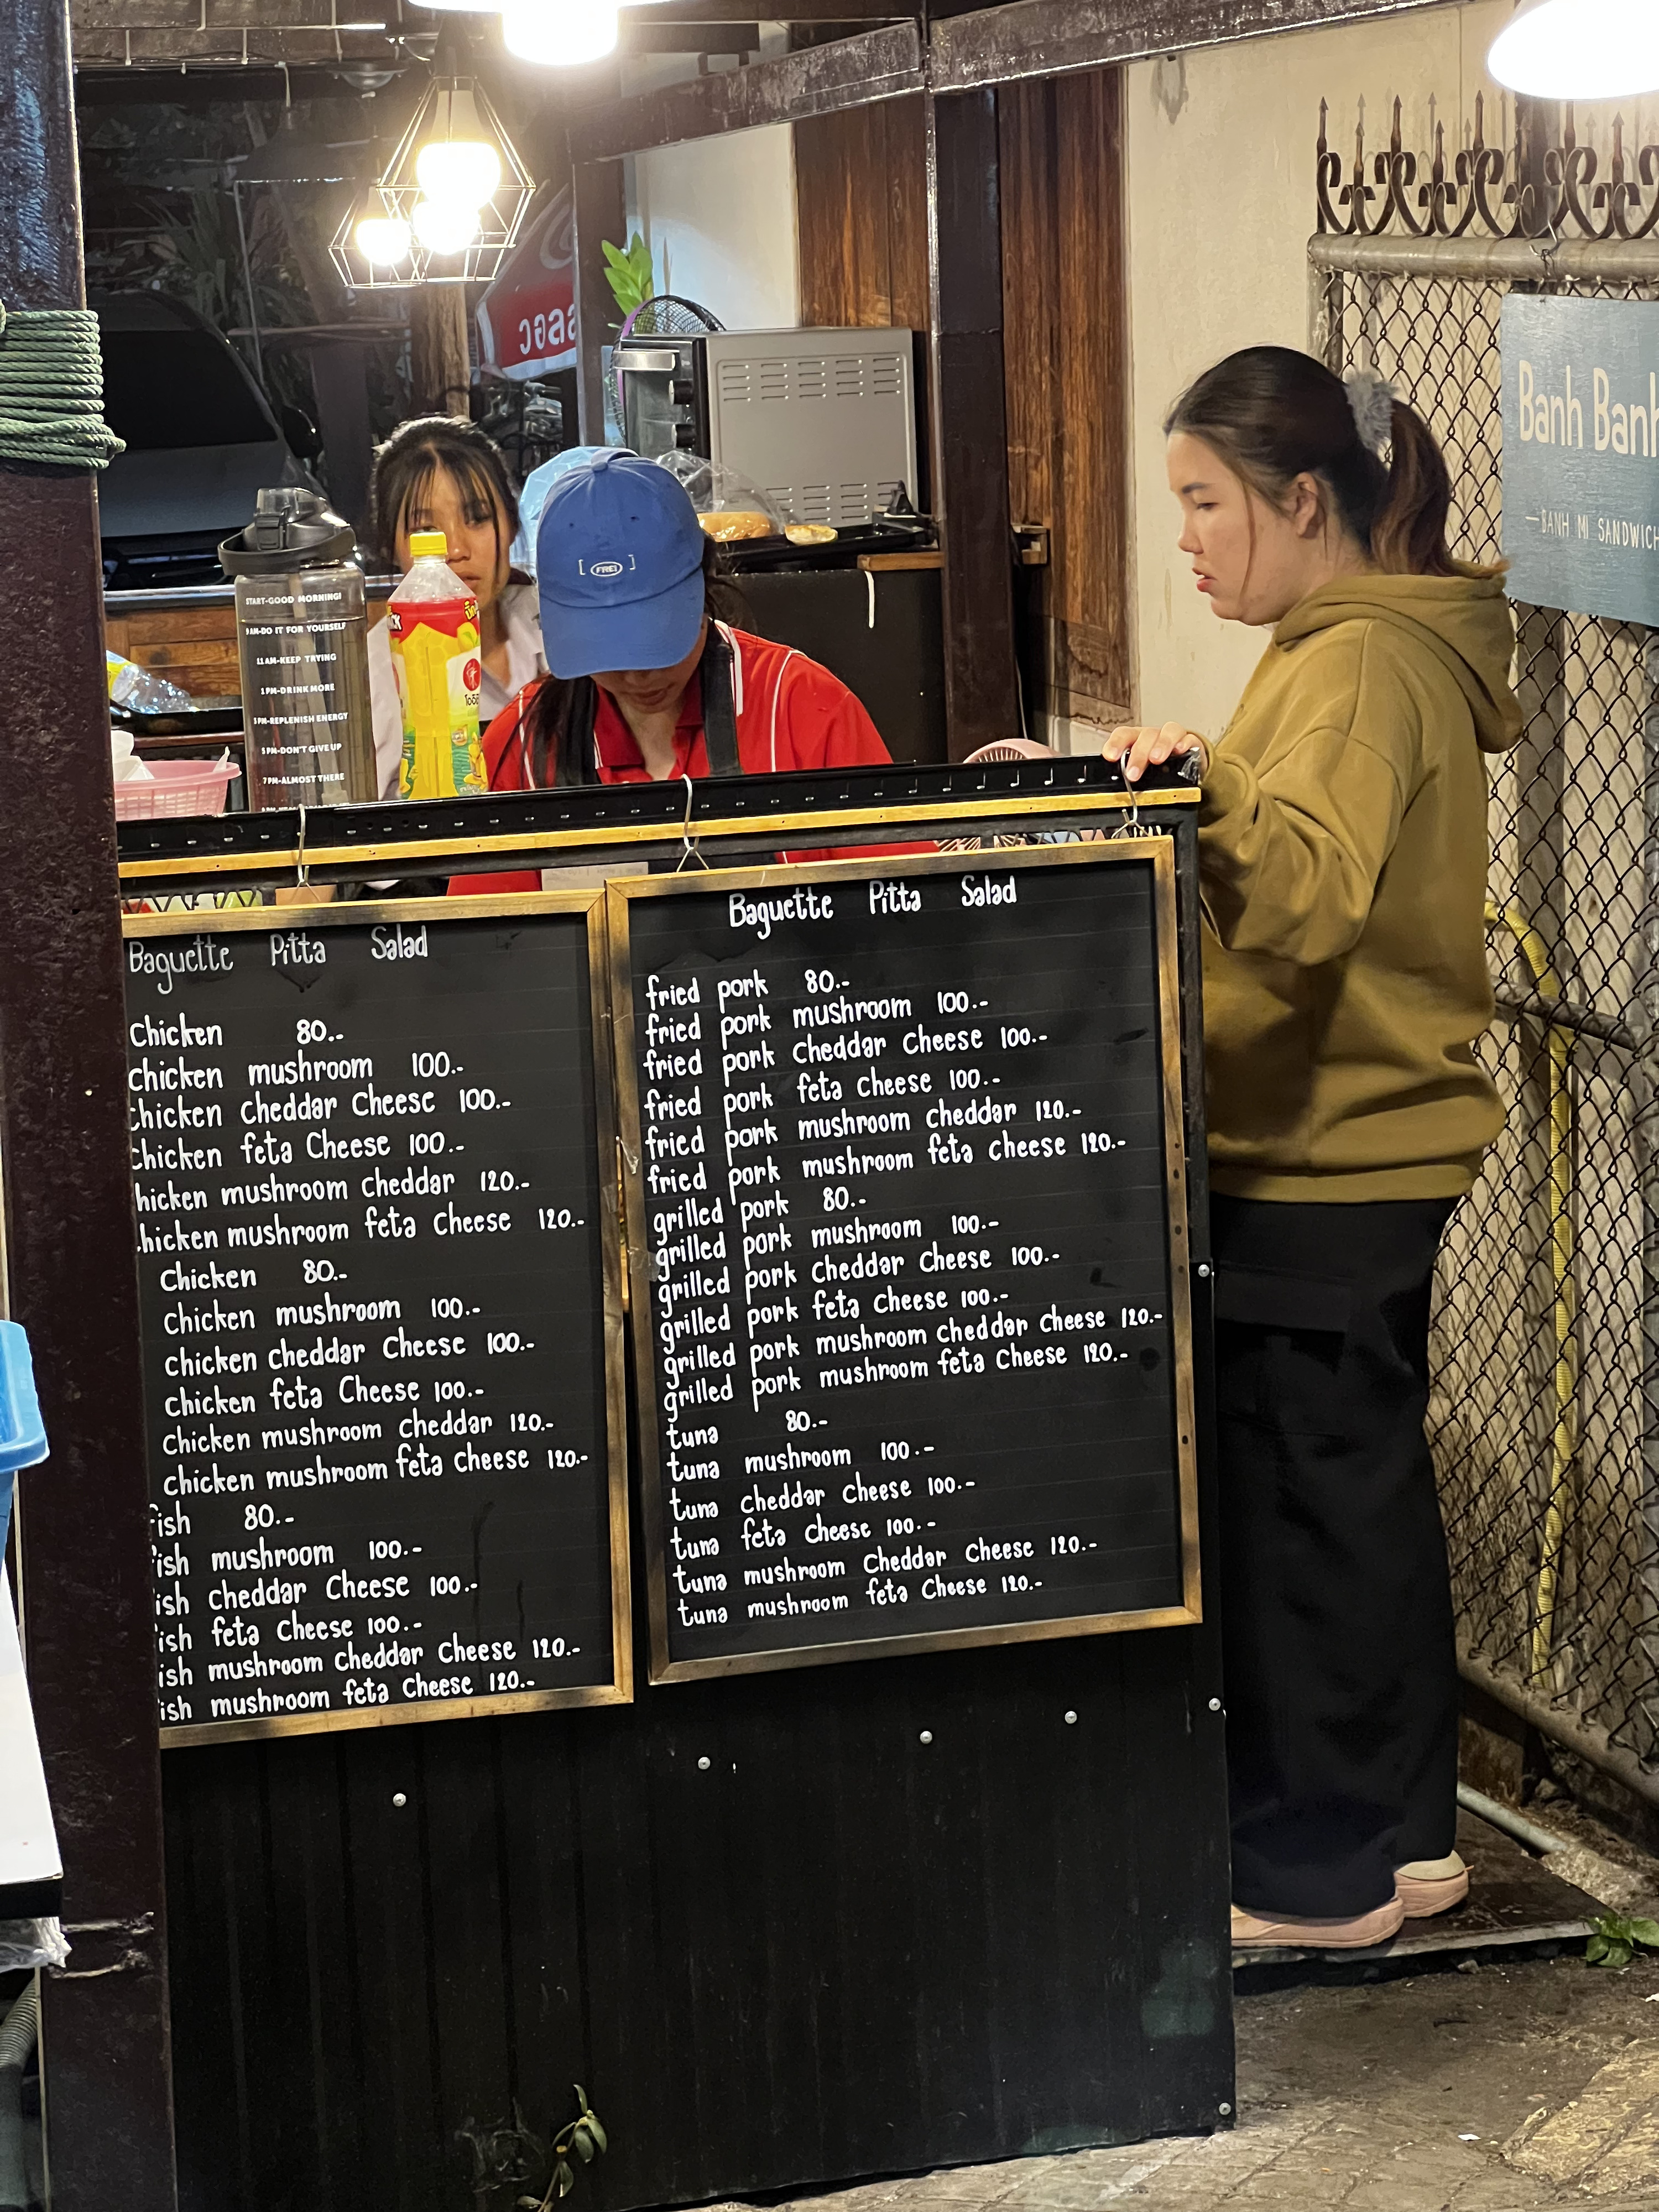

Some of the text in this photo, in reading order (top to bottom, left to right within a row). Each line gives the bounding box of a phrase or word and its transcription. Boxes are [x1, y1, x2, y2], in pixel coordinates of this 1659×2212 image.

[1519, 359, 1659, 458] Banh Banh
[1577, 514, 1589, 540] MI
[285, 625, 304, 634] FOR
[306, 622, 346, 633] YOURSELF
[304, 653, 337, 663] TRYING
[310, 683, 335, 692] MORE
[316, 712, 348, 722] ENERGY
[308, 744, 330, 753] GIVE
[330, 743, 342, 751] UP
[317, 773, 345, 782] THERE
[729, 875, 1017, 940] Baguette Pitta Salad
[130, 924, 429, 995] Baguette Pitta Salad
[645, 974, 701, 1011] fried
[717, 969, 769, 1014] pork
[645, 1012, 701, 1047] fried
[721, 1003, 772, 1051] pork
[792, 995, 912, 1029] mushroom
[248, 1049, 373, 1086] mushroom
[644, 1085, 702, 1120] fried
[723, 1082, 774, 1130] pork
[796, 1071, 843, 1104] feta
[240, 1130, 293, 1165] feta
[645, 1125, 705, 1161] fried
[724, 1118, 779, 1167] pork
[798, 1108, 911, 1140] mushroom
[648, 1161, 707, 1194] fried
[728, 1155, 781, 1206] pork
[802, 1145, 914, 1178] mushroom
[927, 1133, 973, 1165] feta
[137, 1219, 218, 1253] hicken
[227, 1213, 349, 1248] mushroom
[364, 1206, 416, 1239] feta
[653, 1197, 724, 1246] grilled
[740, 1190, 789, 1233] pork
[655, 1231, 726, 1282] grilled
[743, 1222, 792, 1271] pork
[811, 1216, 922, 1249] mushroom
[276, 1291, 401, 1326] mushroom
[660, 1303, 731, 1355] grilled
[747, 1296, 799, 1339] pork
[812, 1289, 860, 1321] feta
[664, 1342, 736, 1390] grilled
[750, 1334, 800, 1378] pork
[816, 1323, 927, 1355] mushroom
[269, 1375, 322, 1410] feta
[664, 1373, 733, 1423] grilled
[752, 1366, 801, 1412] pork
[820, 1356, 928, 1388] mushroom
[937, 1346, 985, 1375] feta
[262, 1417, 382, 1449] mushroom
[666, 1423, 718, 1450] tuna
[266, 1454, 388, 1490] mushroom
[395, 1442, 443, 1478] feta
[666, 1451, 720, 1482] tuna
[745, 1442, 852, 1474] mushroom
[151, 1542, 189, 1578] ish
[211, 1536, 334, 1572] mushroom
[670, 1526, 719, 1560] tuna
[740, 1517, 786, 1551] feta
[672, 1564, 727, 1594] tuna
[744, 1556, 846, 1585] mushroom
[152, 1580, 189, 1616] ish
[677, 1598, 728, 1627] tuna
[747, 1592, 848, 1618] mushroom
[865, 1577, 908, 1605] feta
[154, 1623, 192, 1653] ish
[211, 1615, 259, 1647] feta
[158, 1695, 192, 1721] ish
[211, 1687, 330, 1717] mushroom
[342, 1677, 389, 1704] feta
